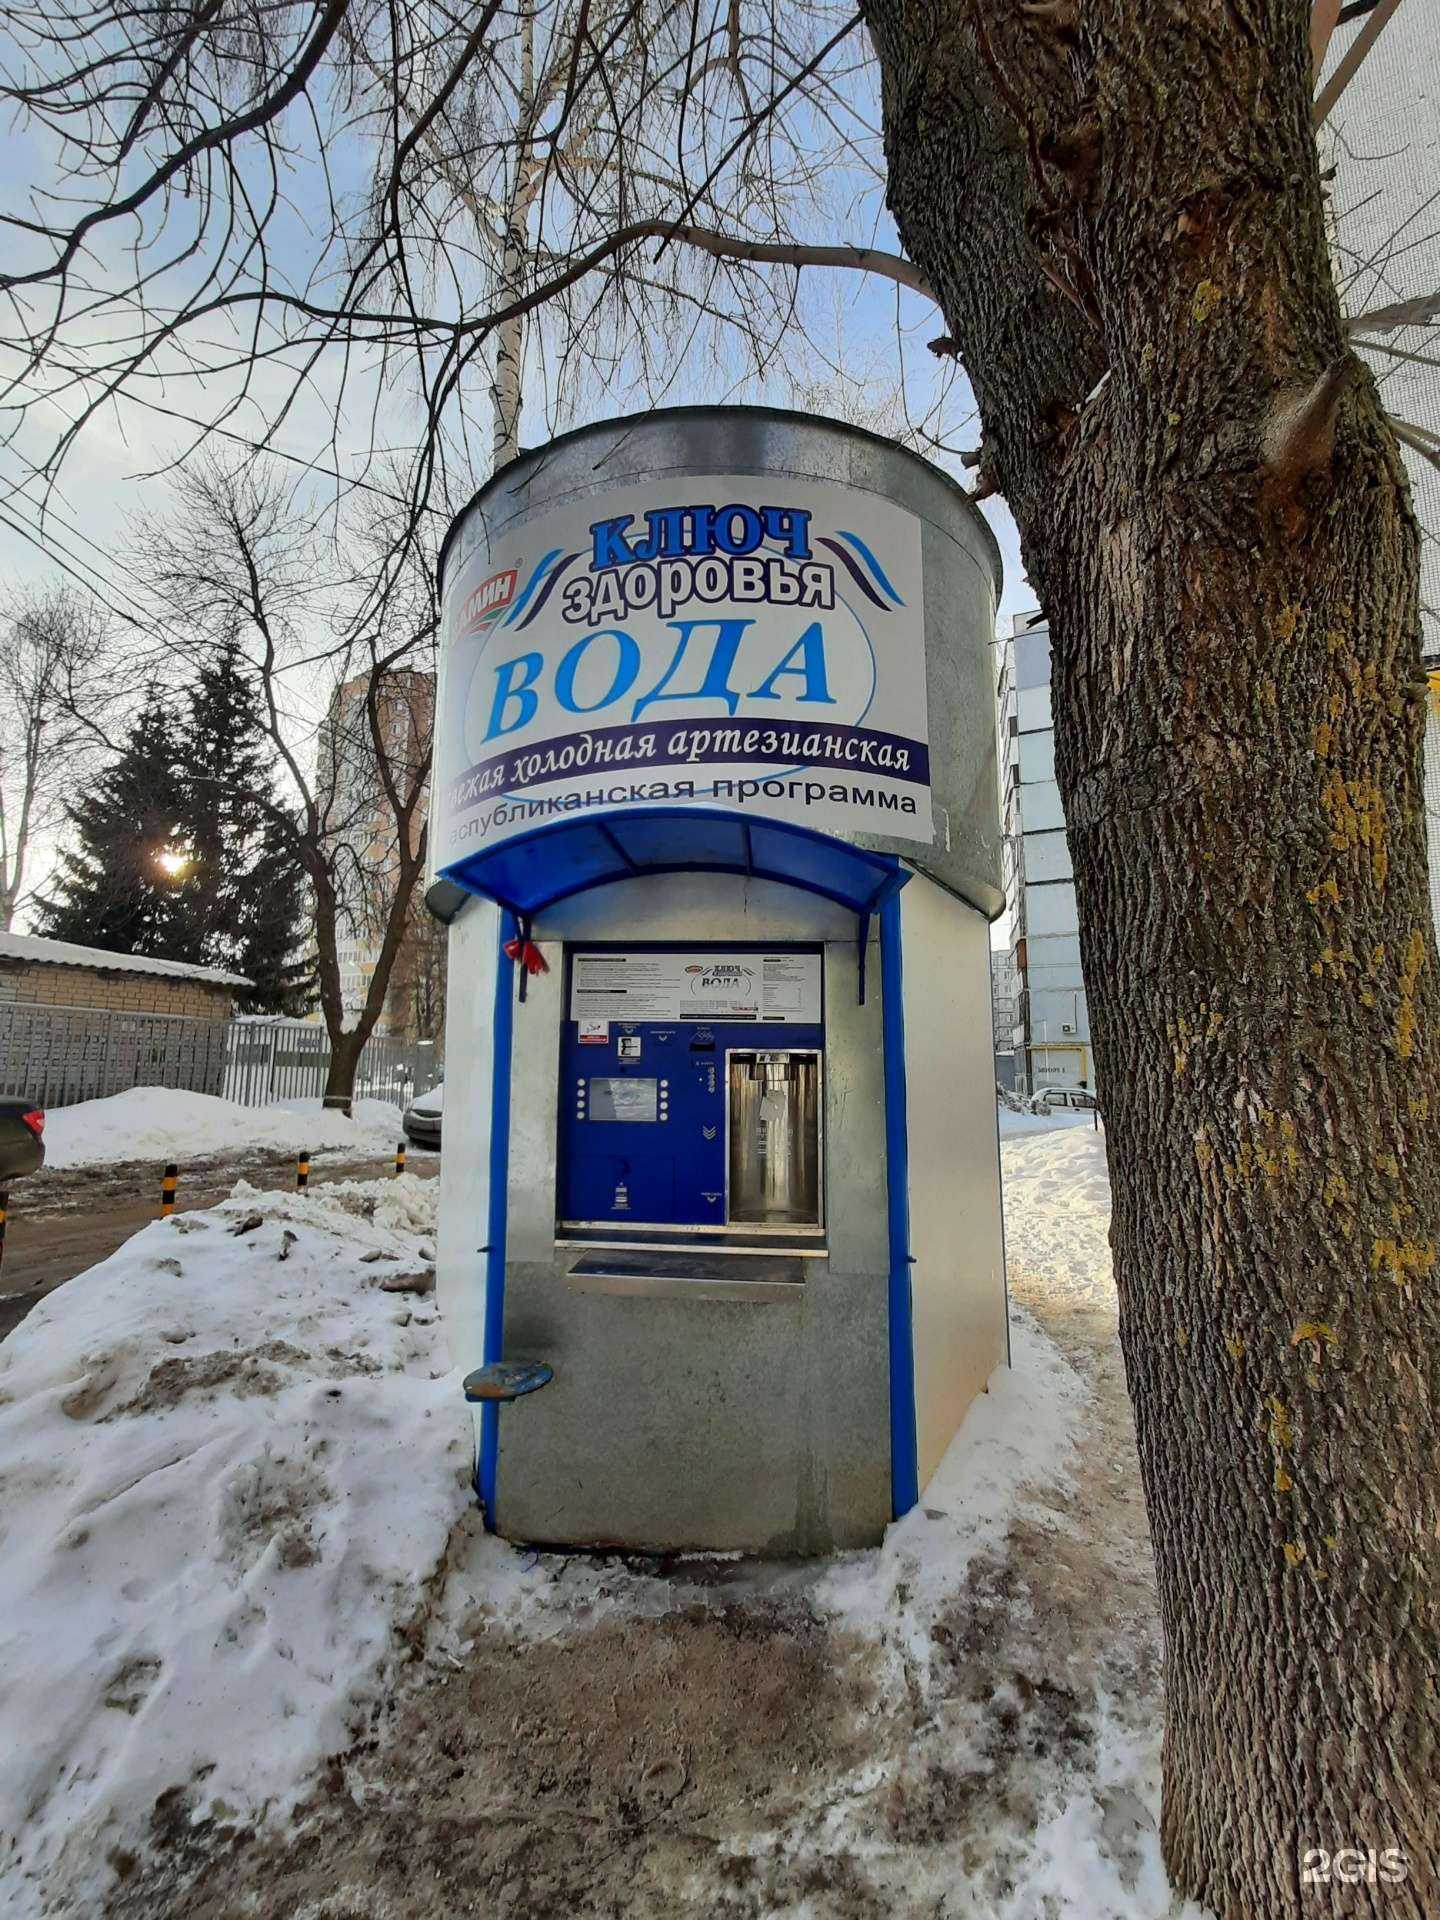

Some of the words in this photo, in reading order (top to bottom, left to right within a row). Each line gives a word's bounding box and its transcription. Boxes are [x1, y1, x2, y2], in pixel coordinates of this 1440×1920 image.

[590, 503, 812, 571] КЛЮЧ
[456, 576, 512, 632] АМИН
[563, 556, 835, 625] ЗДОРОВЬЯ
[481, 619, 837, 744] ВОДА
[511, 732, 656, 784] холодная
[668, 729, 910, 771] артезианская
[449, 781, 694, 847] еспубликанская
[712, 777, 917, 814] программа
